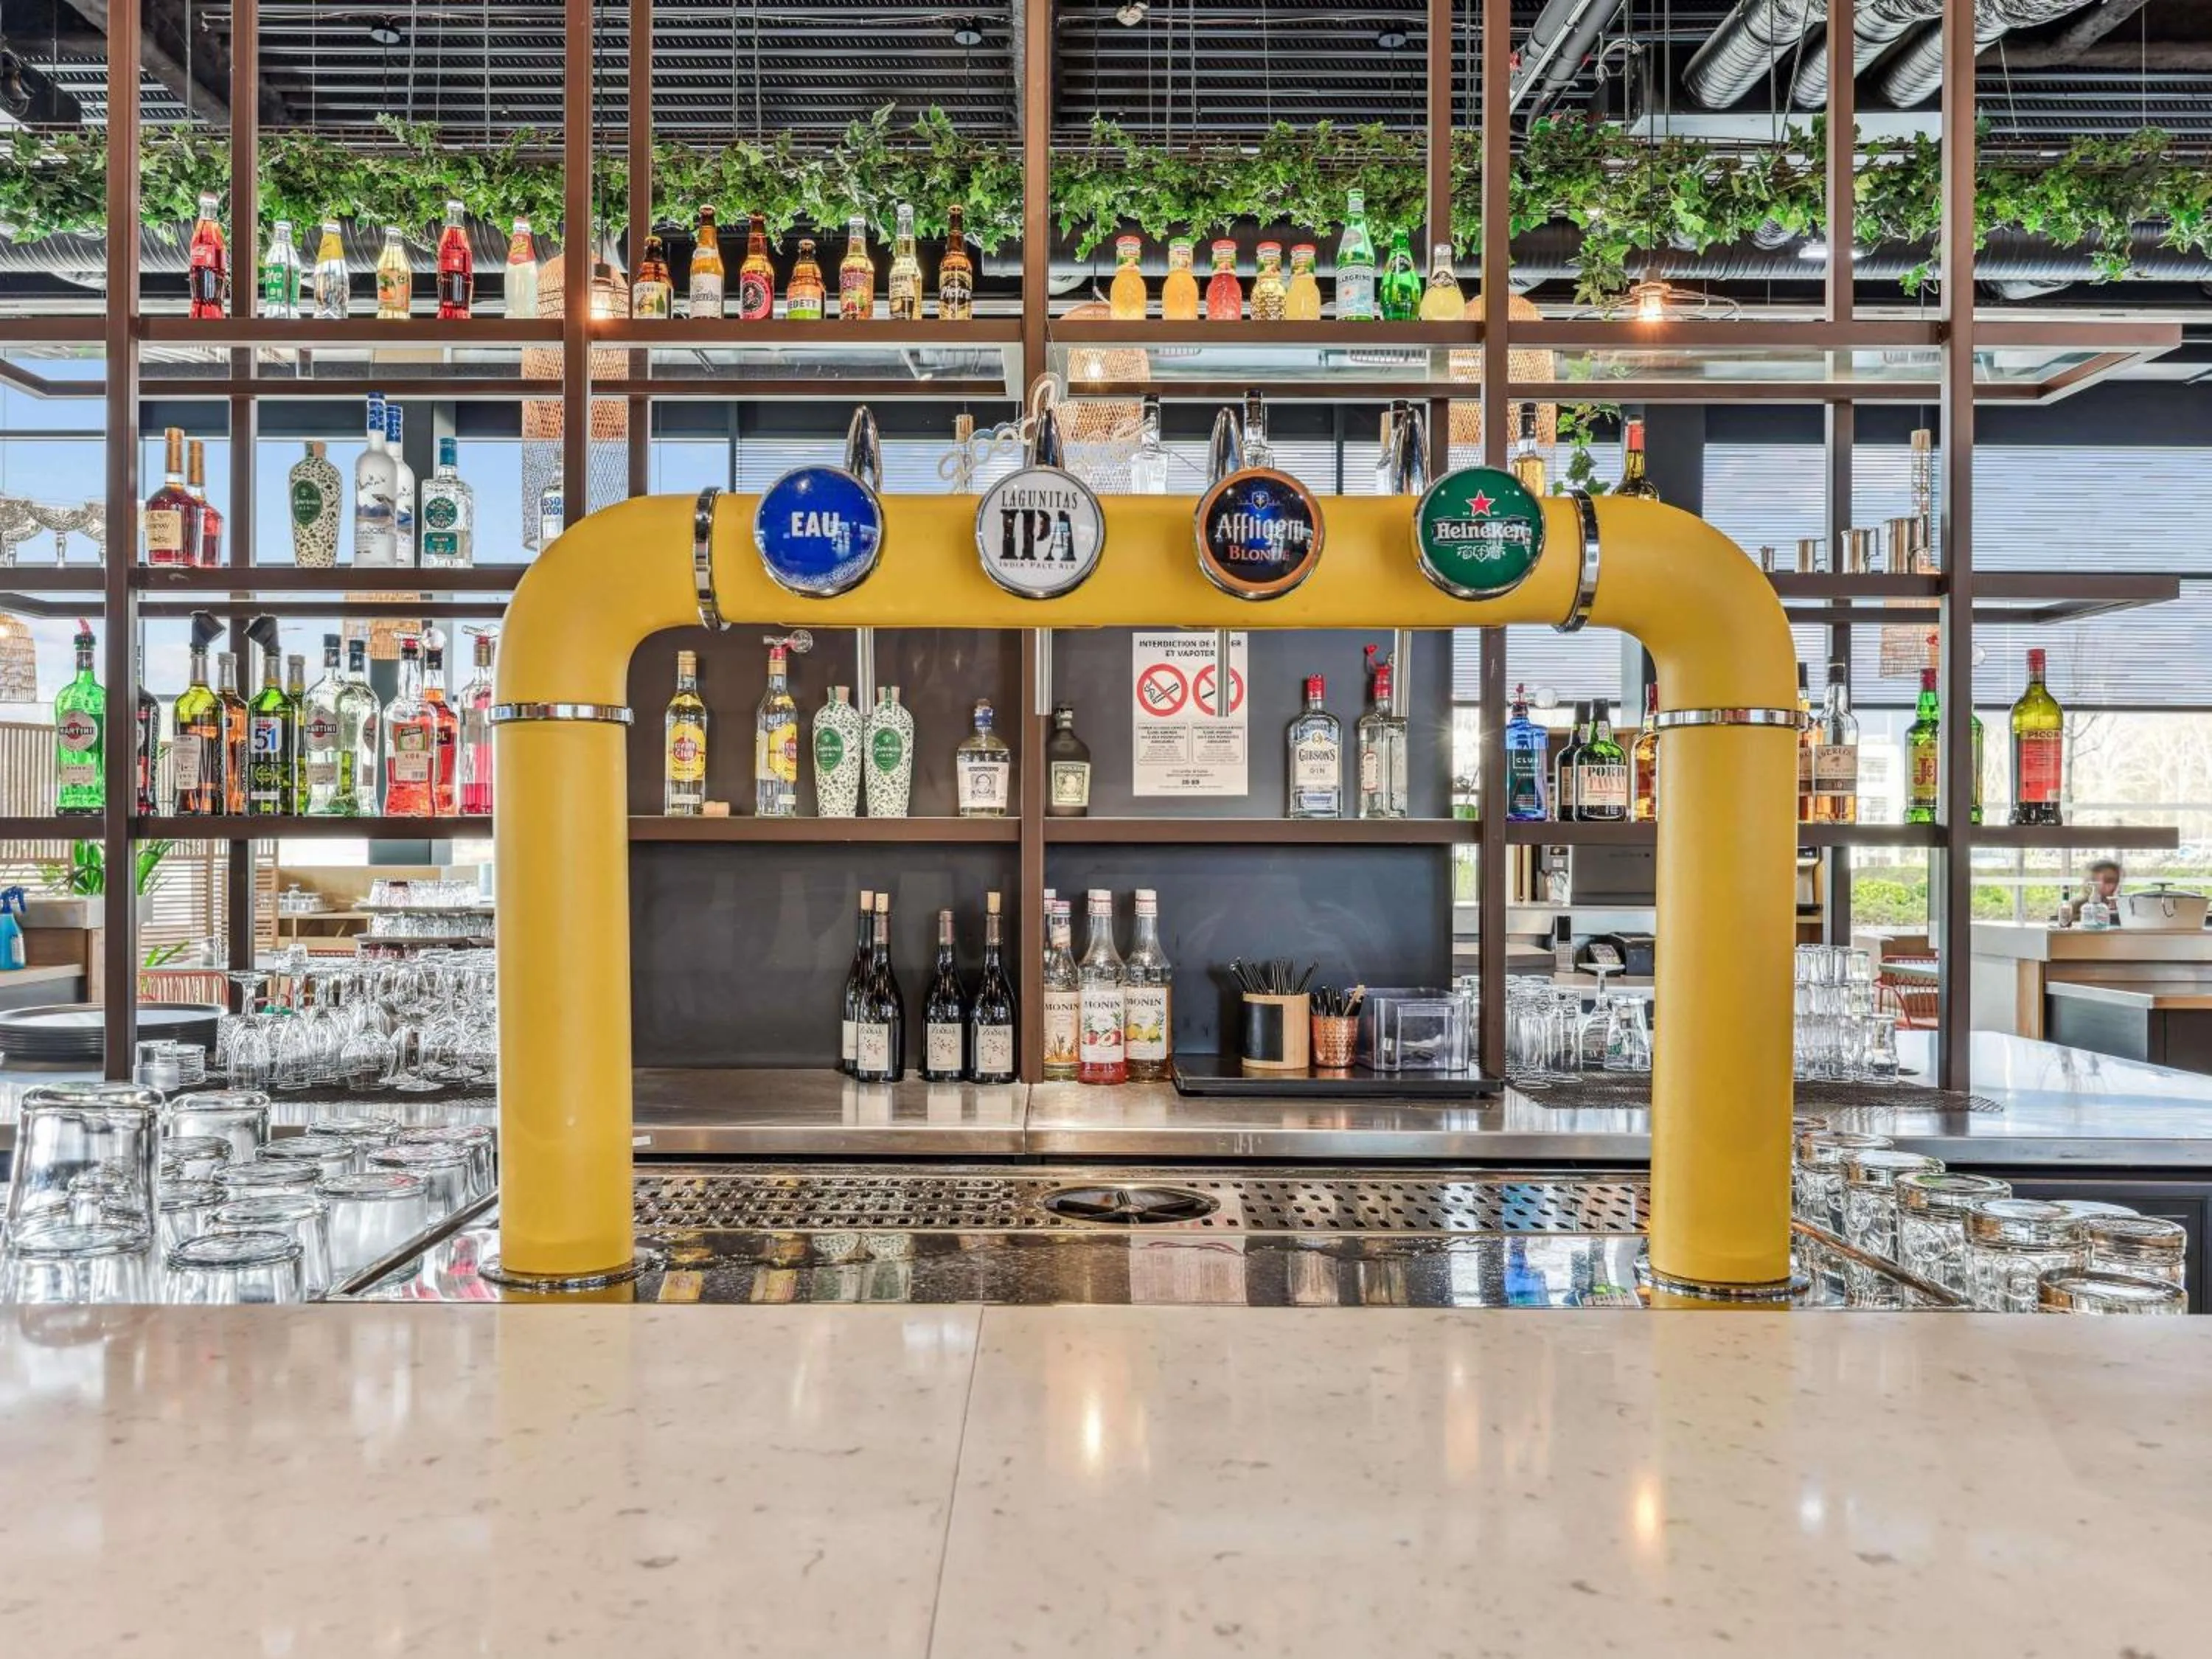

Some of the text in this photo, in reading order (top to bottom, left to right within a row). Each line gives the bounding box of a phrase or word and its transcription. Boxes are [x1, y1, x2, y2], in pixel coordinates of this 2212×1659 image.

[1001, 490, 1077, 509] LAGUNITAS
[791, 511, 840, 538] EAU
[1215, 512, 1304, 545] Affligem
[1436, 522, 1529, 542] Heineken
[1000, 509, 1077, 562] IPA
[254, 728, 276, 750] 51
[1044, 1002, 1079, 1011] MONIN
[1084, 999, 1121, 1009] MONIN
[1124, 997, 1162, 1006] MONIN
